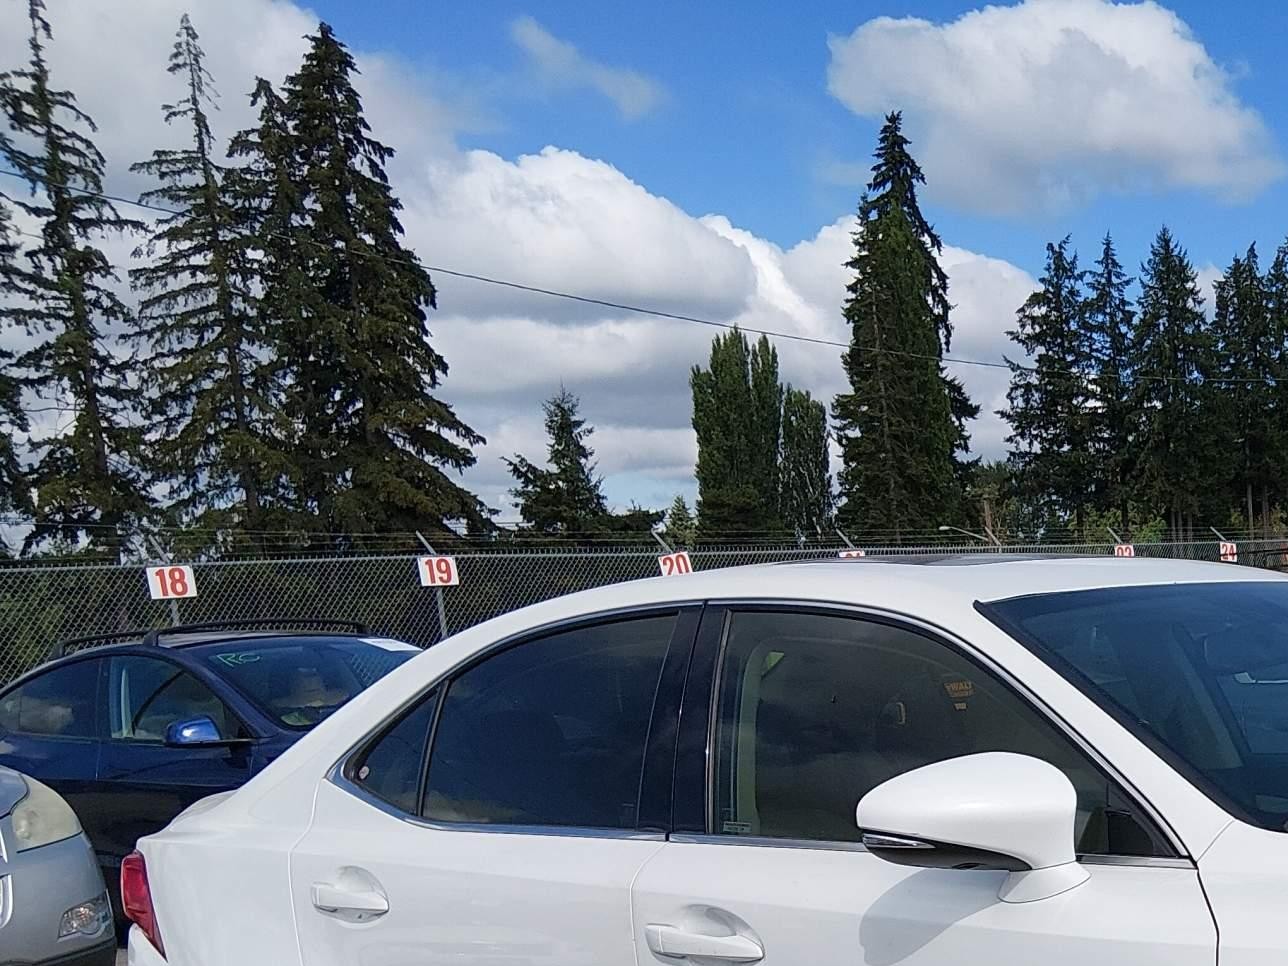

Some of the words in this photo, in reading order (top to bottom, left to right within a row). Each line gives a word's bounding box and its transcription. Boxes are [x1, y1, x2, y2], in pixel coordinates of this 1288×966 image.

[1221, 543, 1235, 560] 24
[425, 558, 452, 584] 19
[662, 554, 690, 575] 20
[155, 567, 188, 597] 18
